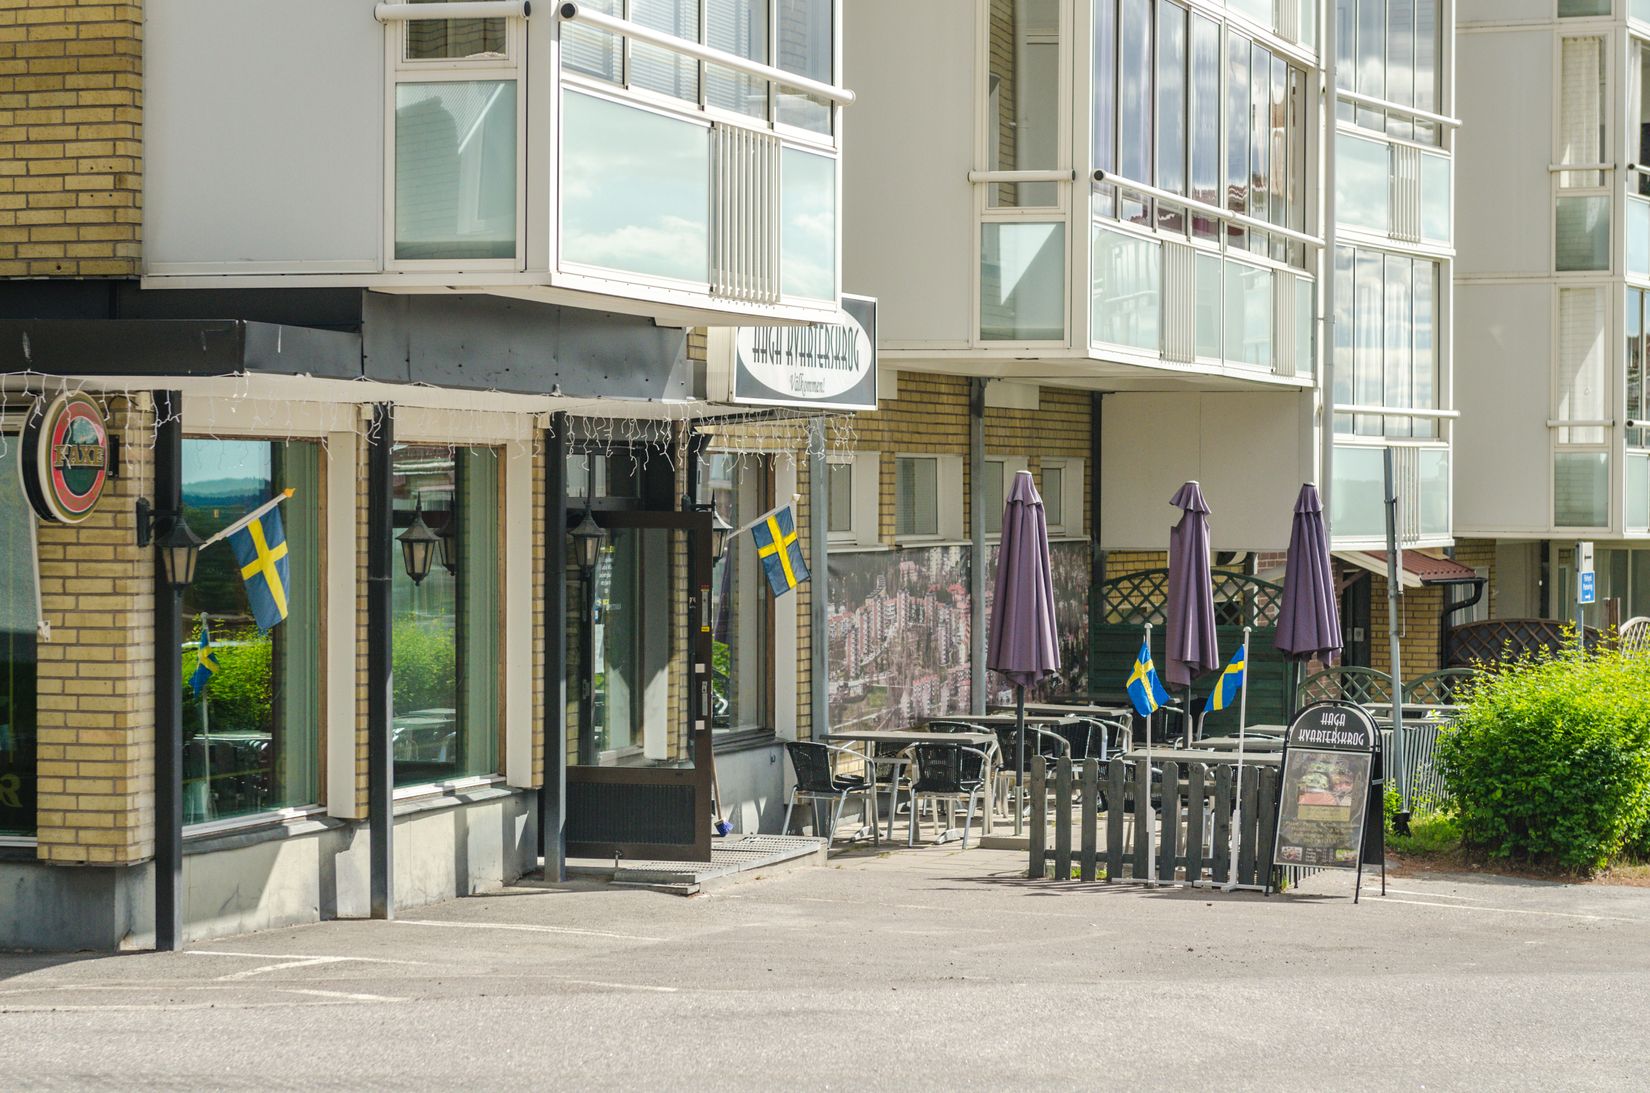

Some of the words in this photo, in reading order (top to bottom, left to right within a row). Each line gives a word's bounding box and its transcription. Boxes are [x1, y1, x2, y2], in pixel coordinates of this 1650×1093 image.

[752, 325, 782, 365] HAGA
[54, 445, 104, 467] FAXE
[1321, 713, 1346, 727] HAGA
[1298, 729, 1365, 746] KVARTERSKROG
